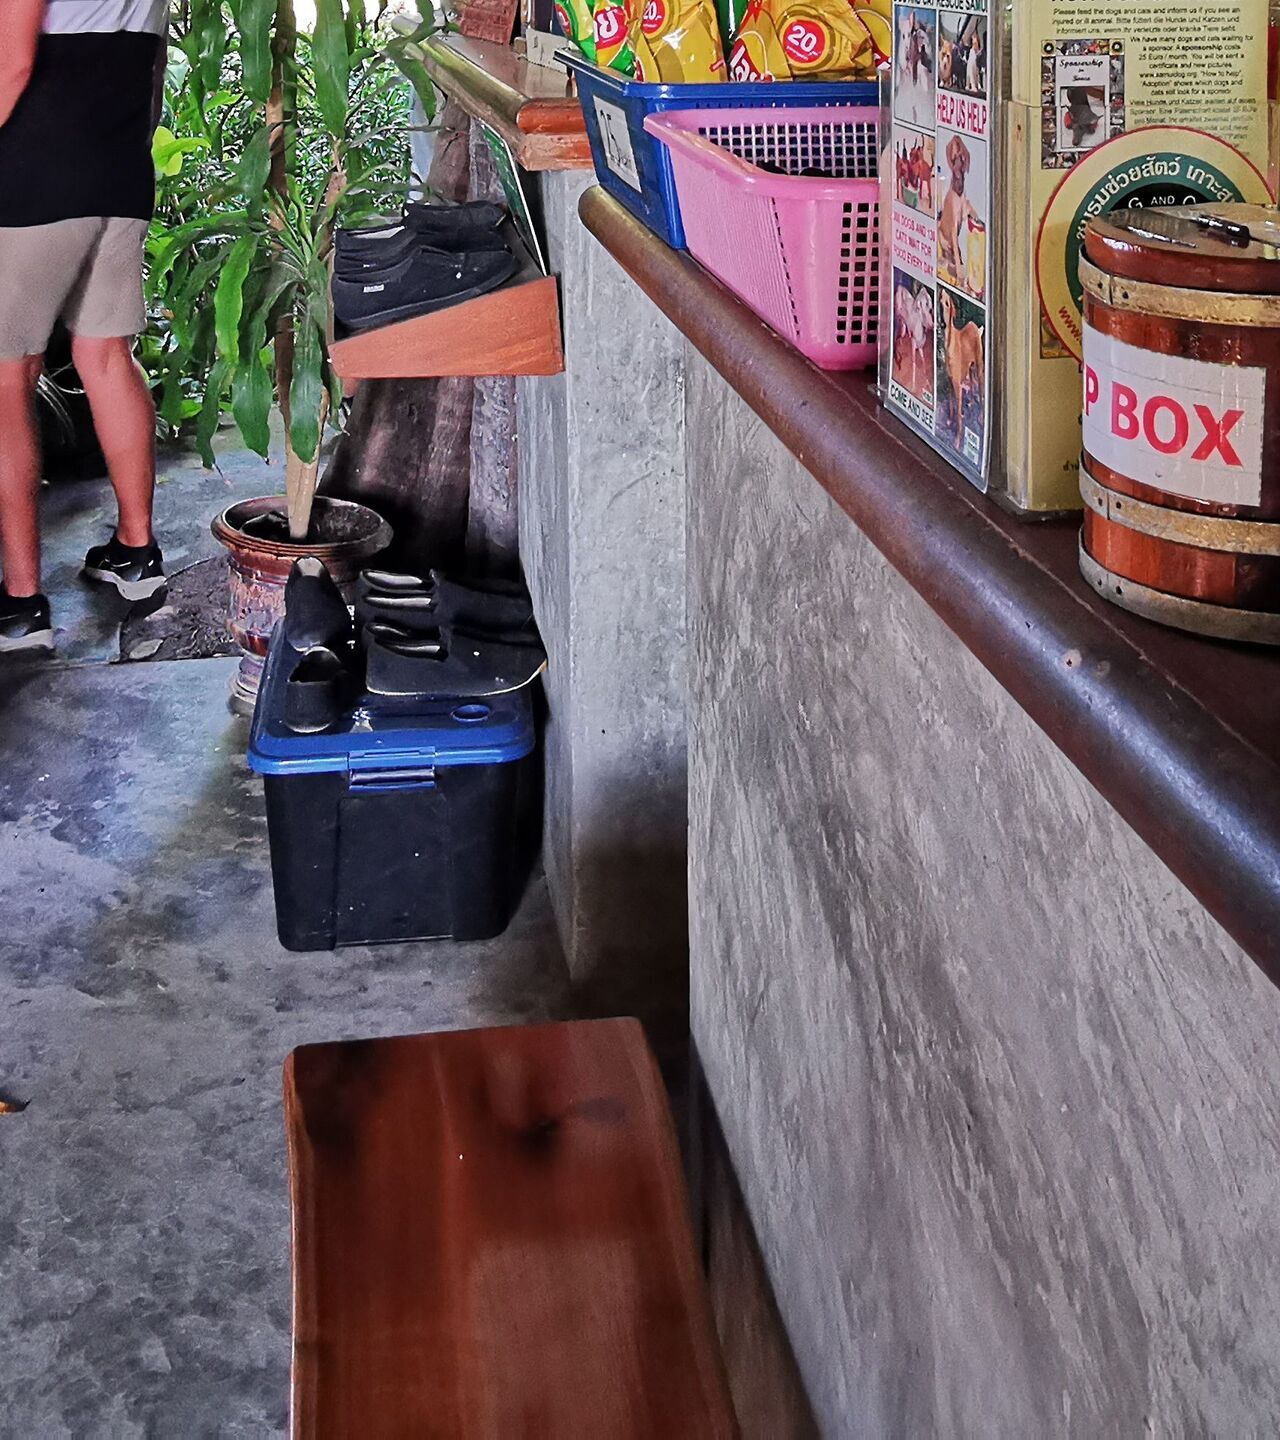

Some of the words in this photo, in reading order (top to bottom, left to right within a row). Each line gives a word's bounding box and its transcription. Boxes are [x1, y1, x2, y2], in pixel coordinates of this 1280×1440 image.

[937, 94, 954, 125] HELP
[956, 98, 966, 130] US
[968, 101, 987, 135] HELP
[1150, 195, 1175, 208] AND
[890, 385, 907, 407] COME
[907, 397, 920, 419] AND
[920, 406, 934, 430] SEE
[1111, 380, 1246, 467] BOX
